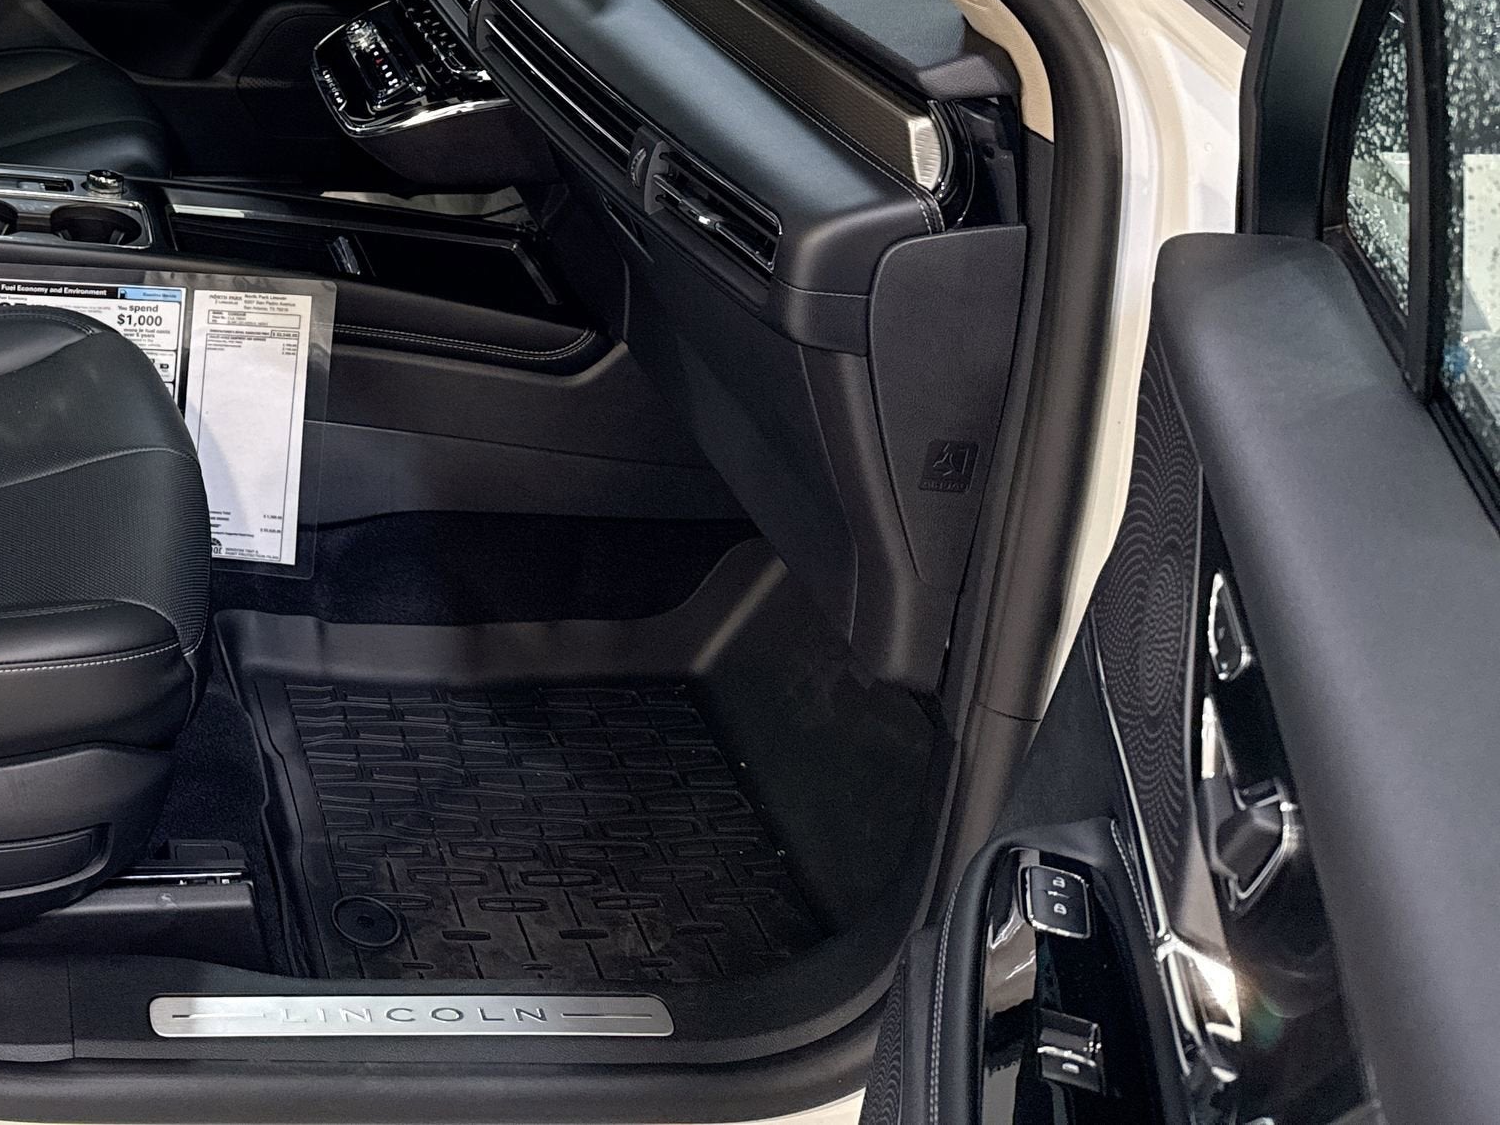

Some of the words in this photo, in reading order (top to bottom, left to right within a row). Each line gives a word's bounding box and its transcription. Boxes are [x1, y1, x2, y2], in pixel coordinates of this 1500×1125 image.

[1, 283, 16, 292] Fuel
[17, 285, 48, 294] Economy
[50, 286, 63, 294] and
[64, 286, 107, 296] Environment
[129, 304, 159, 315] spend
[117, 313, 163, 327] $1,000
[278, 1005, 548, 1025] LINCOLN
